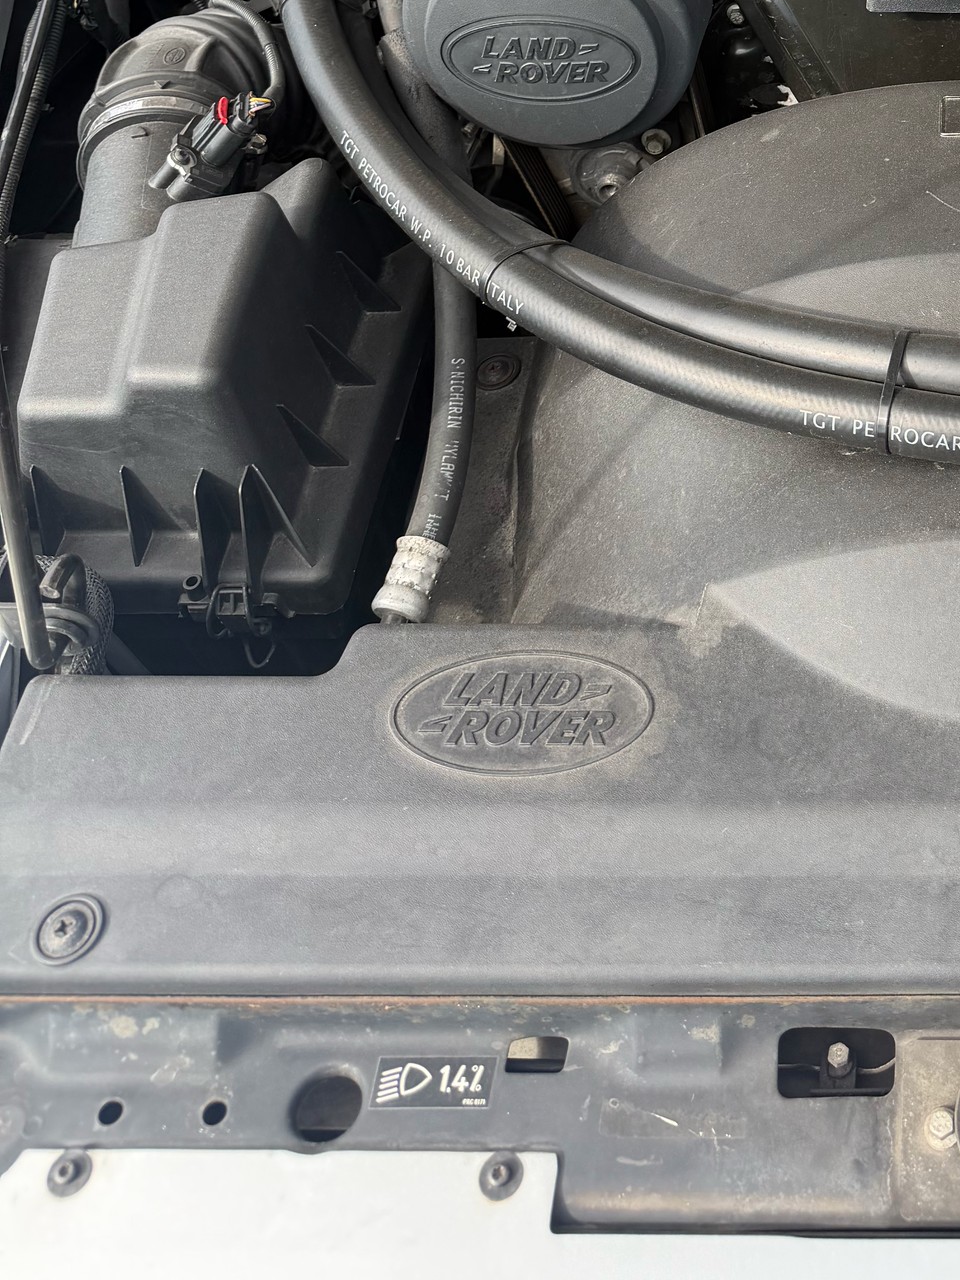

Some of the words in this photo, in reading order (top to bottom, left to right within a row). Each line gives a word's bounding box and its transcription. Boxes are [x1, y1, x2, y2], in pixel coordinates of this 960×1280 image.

[481, 35, 577, 60] LAND
[494, 60, 611, 84] ROVER
[339, 130, 360, 159] TGT
[358, 157, 407, 222] PETROCAR
[410, 216, 433, 248] W.P.
[439, 244, 455, 265] 10
[456, 257, 481, 286] BAR
[486, 280, 524, 315] ITALY
[800, 409, 841, 431] TGT
[443, 671, 583, 708] LAND
[444, 709, 617, 748] ROVER
[440, 1064, 485, 1093] 1.4%
